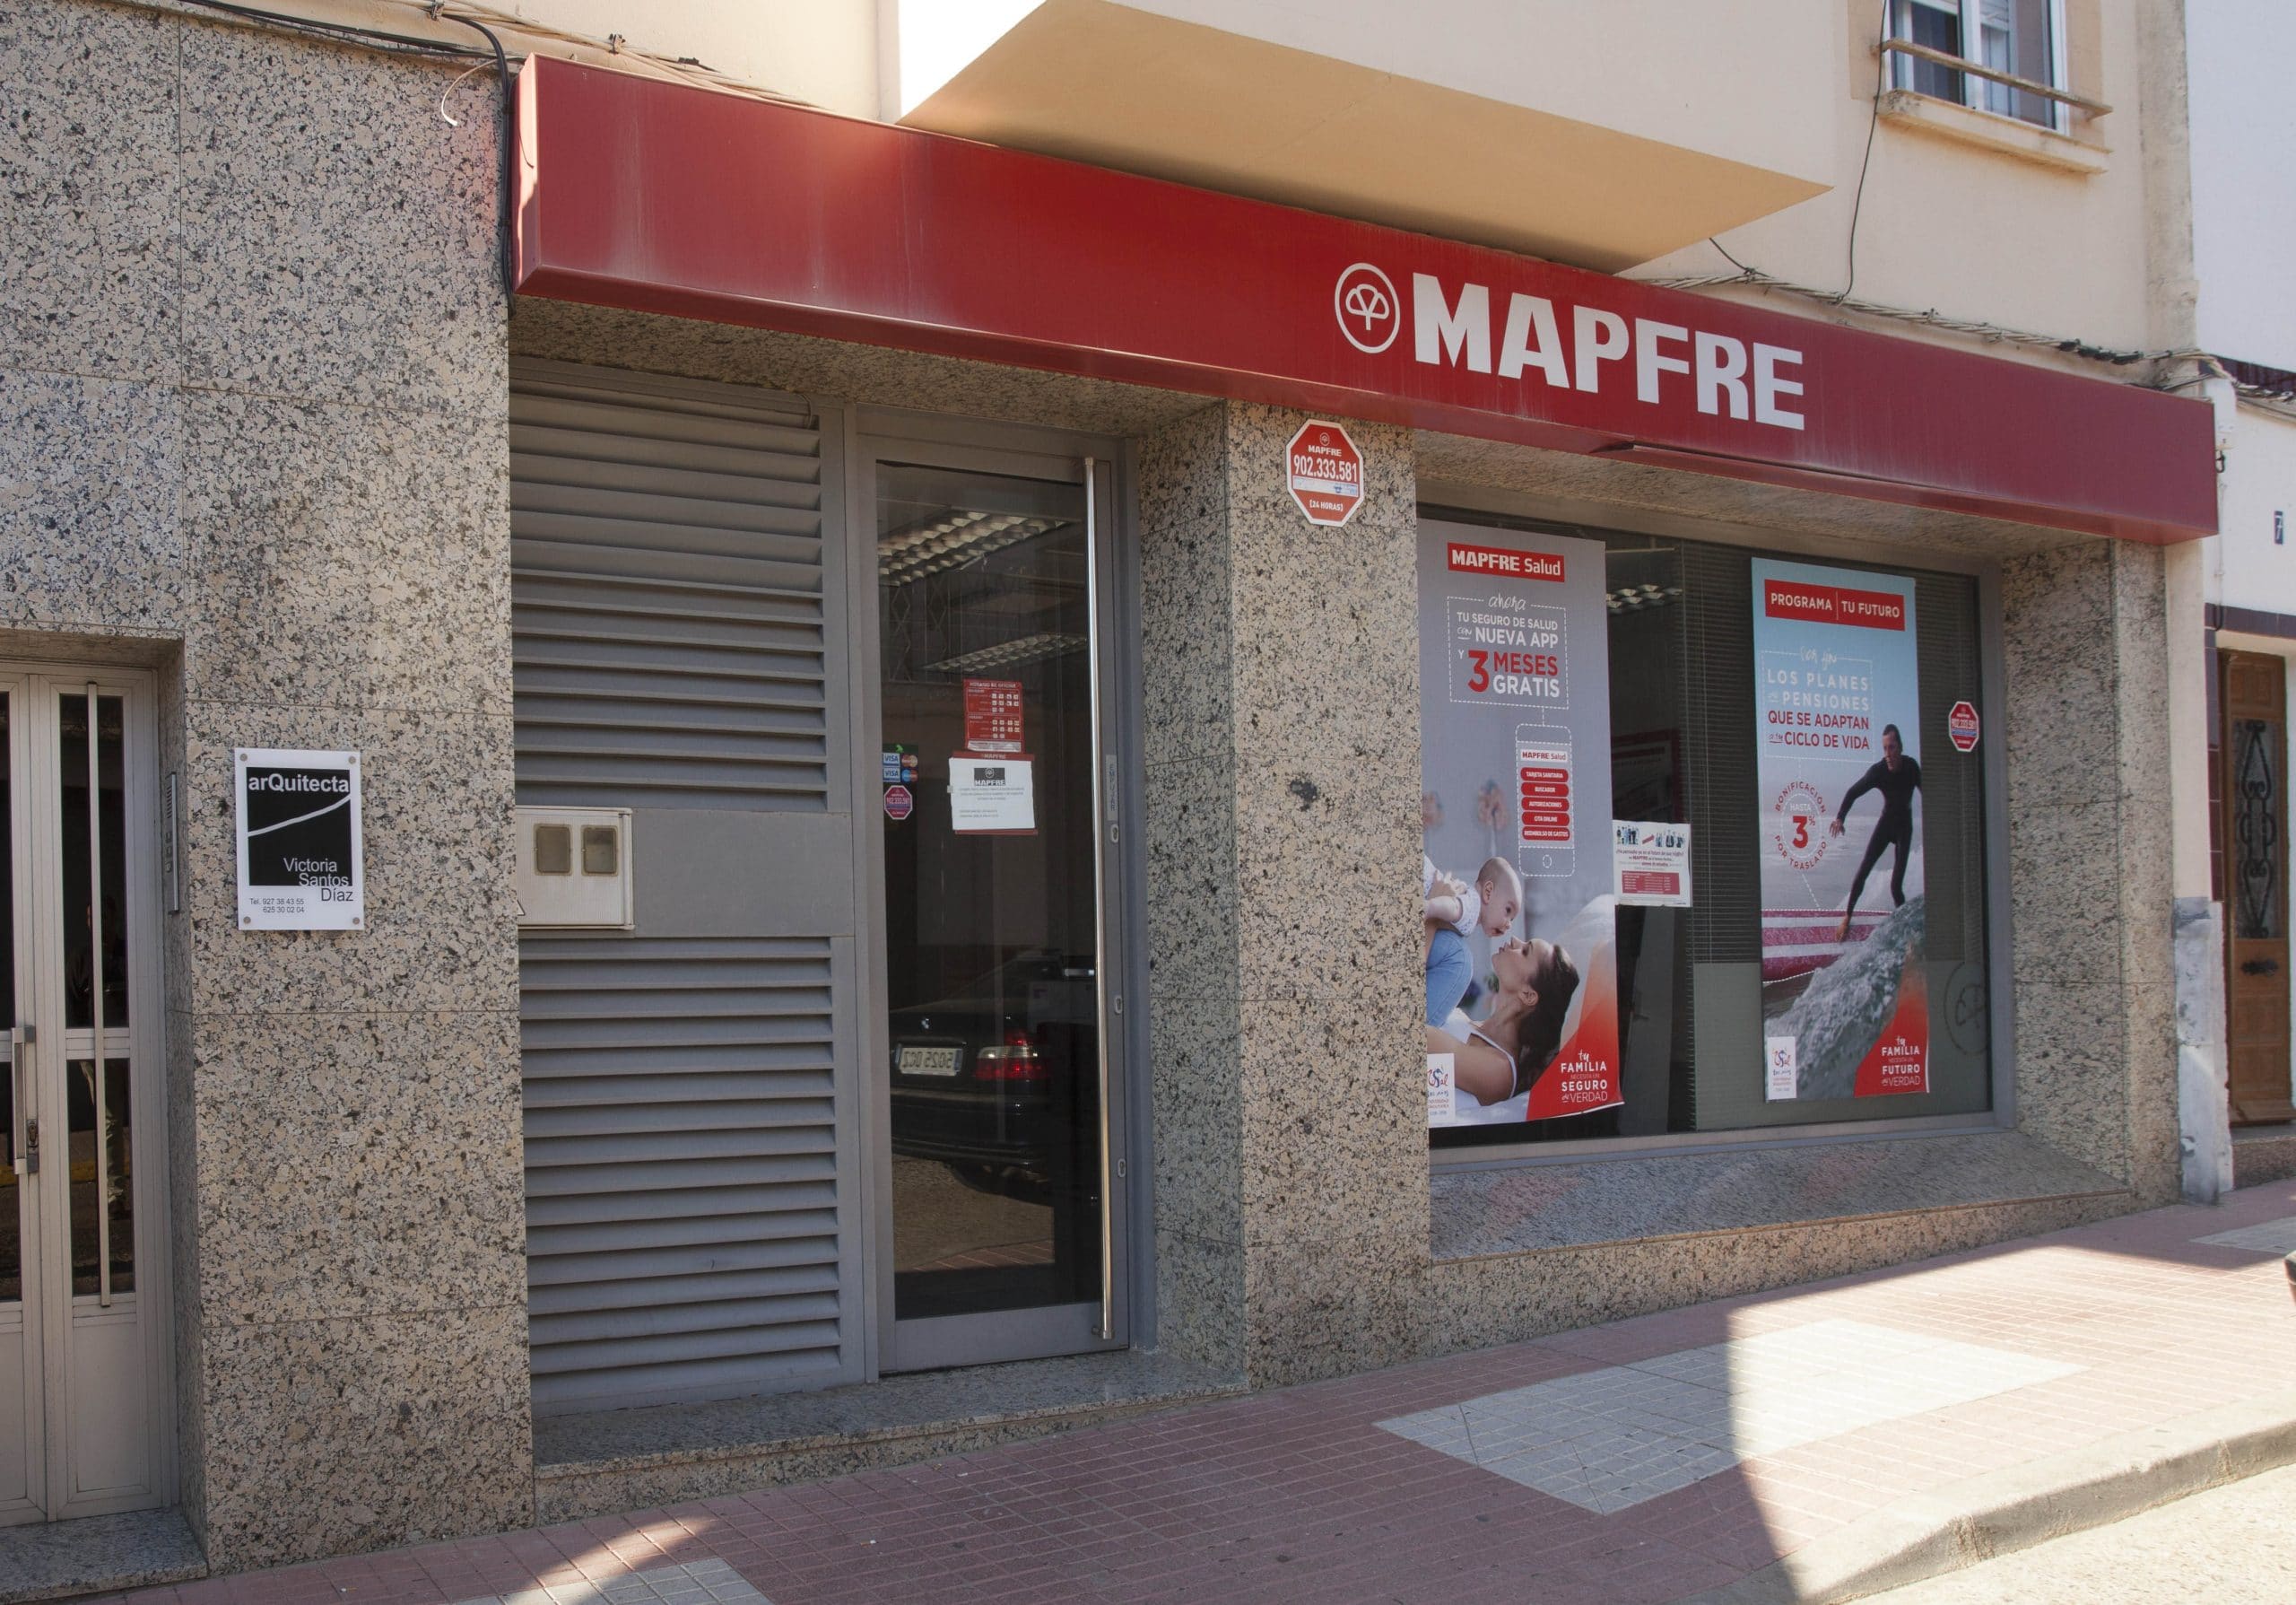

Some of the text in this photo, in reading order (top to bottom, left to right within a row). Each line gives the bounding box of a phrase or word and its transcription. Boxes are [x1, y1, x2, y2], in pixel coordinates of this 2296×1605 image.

[1413, 272, 1805, 432] MAPFRE
[1308, 445, 1343, 457] MAPFRE
[1293, 454, 1357, 483] 902.333.581
[1452, 549, 1561, 576] MAPFRE Salud
[1488, 592, 1526, 612] ahora
[1770, 592, 1900, 618] PROGRAMA TU FUTURO
[1457, 611, 1558, 631] TU SEGURO DE SALUD
[1475, 626, 1526, 646] NUEVA
[1530, 632, 1559, 649] APP
[1458, 650, 1558, 693] Y 3 MESES
[1767, 668, 1869, 691] LOS PLANES
[1492, 675, 1561, 698] GRATIS
[1783, 691, 1869, 711] PENSIONES
[1768, 710, 1869, 729] QUE SE ADAPTAN
[1784, 731, 1820, 747] CICLO
[1823, 734, 1839, 748] DE
[1842, 735, 1870, 750] VIDA
[1522, 752, 1550, 760] MAPFRE
[248, 772, 350, 792] arQuitecta
[283, 857, 338, 873] Victoria
[298, 872, 349, 887] Santos
[320, 887, 354, 902] Díaz
[1578, 1049, 1589, 1062] tu
[1882, 1045, 1920, 1057] FAMILIA
[1561, 1060, 1607, 1073] FAMILIA
[1882, 1064, 1920, 1075] FUTURO
[1561, 1079, 1607, 1092] SEGURO
[1888, 1076, 1920, 1086] VERDAD
[1570, 1091, 1608, 1103] VERDAD
